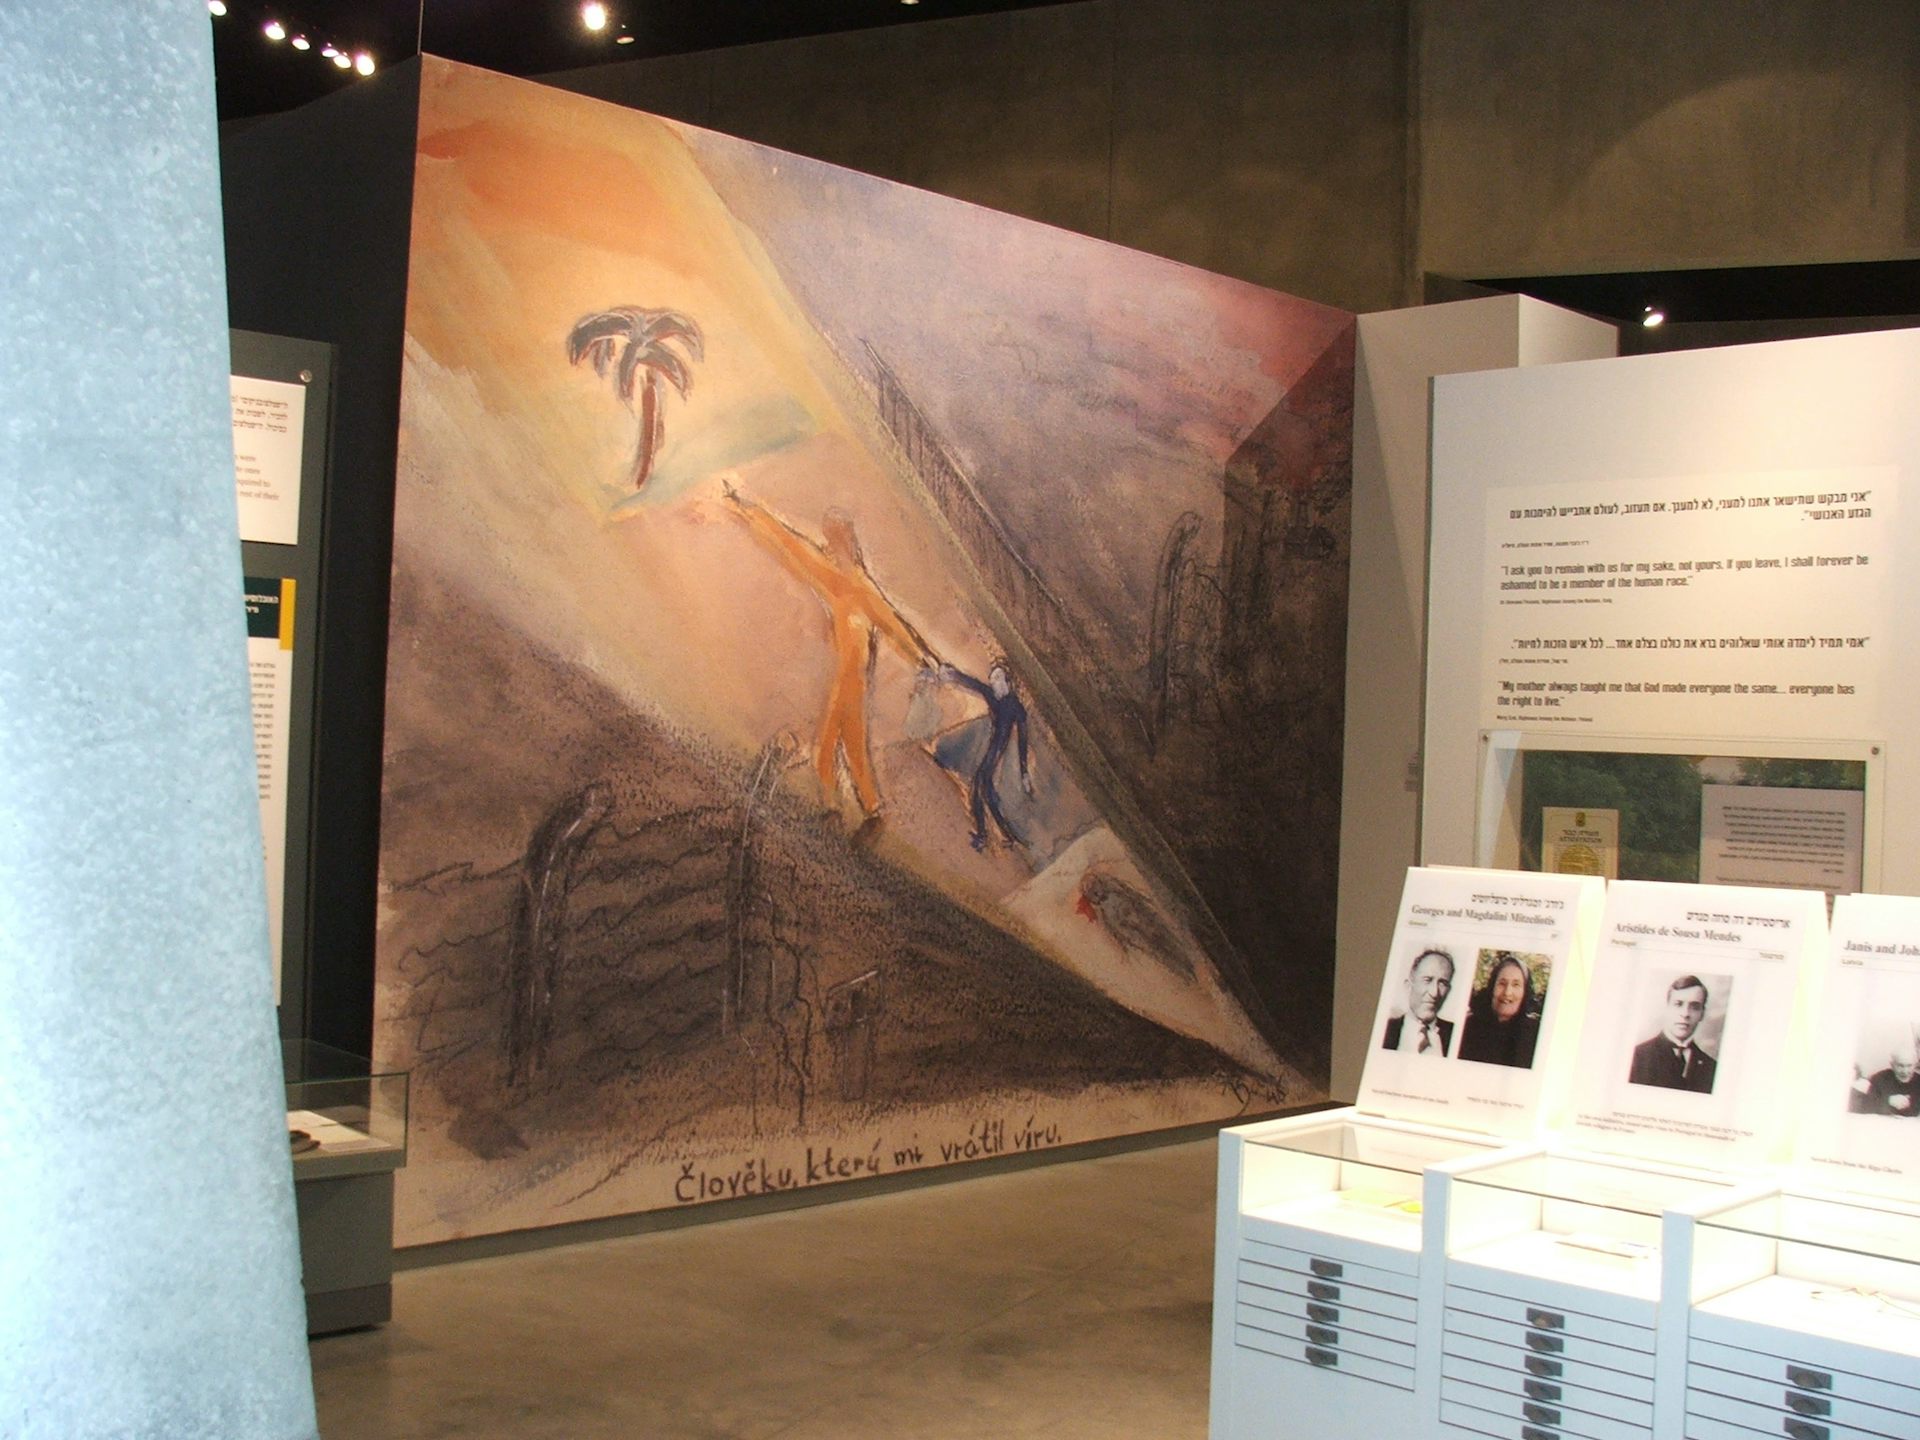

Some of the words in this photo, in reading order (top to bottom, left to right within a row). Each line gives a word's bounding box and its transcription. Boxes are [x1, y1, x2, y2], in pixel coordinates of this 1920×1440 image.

[1701, 498, 1713, 510] לא
[1748, 496, 1770, 507] אתנו
[1773, 493, 1814, 506] שתישאר
[1818, 491, 1847, 506] מבקש
[1523, 505, 1557, 519] להימנות
[1559, 505, 1591, 518] אתבייש
[1593, 502, 1619, 516] לעולם
[1652, 501, 1665, 512] אם
[1848, 507, 1872, 519] הגזע
[1509, 508, 1522, 520] עם
[1510, 564, 1525, 576] ask
[1527, 566, 1542, 578] you
[1544, 565, 1553, 575] to
[1554, 563, 1585, 575] remain
[1587, 562, 1606, 574] with
[1607, 563, 1618, 573] us
[1620, 561, 1634, 573] for
[1636, 562, 1650, 575] my
[1679, 559, 1692, 571] not
[1735, 558, 1752, 572] you
[1790, 556, 1813, 568] shall
[1816, 555, 1854, 567] forever
[1856, 554, 1869, 566] be
[1500, 579, 1537, 591] ashamed
[1538, 579, 1548, 590] to
[1550, 579, 1560, 590] be
[1561, 580, 1567, 590] a
[1569, 578, 1605, 590] member
[1607, 577, 1616, 589] of
[1617, 577, 1633, 588] the
[1634, 576, 1663, 588] human
[1543, 638, 1567, 649] הזכות
[1569, 638, 1587, 649] איש
[1589, 637, 1603, 649] לכל
[1635, 637, 1658, 649] בצלם
[1660, 637, 1681, 649] כולנו
[1684, 638, 1697, 648] את
[1700, 638, 1717, 649] ברא
[1719, 635, 1760, 649] שאלוהים
[1763, 637, 1785, 648] אותי
[1787, 635, 1815, 648] לימדה
[1818, 637, 1843, 648] תמיד
[1516, 681, 1546, 691] mother
[1548, 681, 1578, 693] always
[1580, 681, 1606, 694] taught
[1608, 683, 1622, 692] me
[1624, 681, 1641, 692] that
[1643, 682, 1660, 693] God
[1662, 682, 1686, 693] made
[1689, 683, 1731, 695] everyone
[1734, 682, 1749, 694] the
[1789, 683, 1834, 696] everyone
[1836, 682, 1855, 694] has
[1497, 695, 1510, 706] the
[1512, 695, 1532, 708] right
[1534, 696, 1543, 706] to
[1411, 904, 1445, 917] Georges
[1446, 906, 1462, 918] and
[1614, 922, 1656, 936] Aristides
[1658, 927, 1670, 937] de
[1673, 927, 1700, 939] Sousa
[1703, 929, 1742, 943] Mendes
[1843, 940, 1873, 952] Janis
[1875, 944, 1896, 955] and
[675, 1158, 799, 1201] Člověku,
[806, 1137, 882, 1184] který
[894, 1132, 923, 1166] mi
[940, 1118, 1005, 1162] vrátil
[1014, 1114, 1062, 1151] víru.
